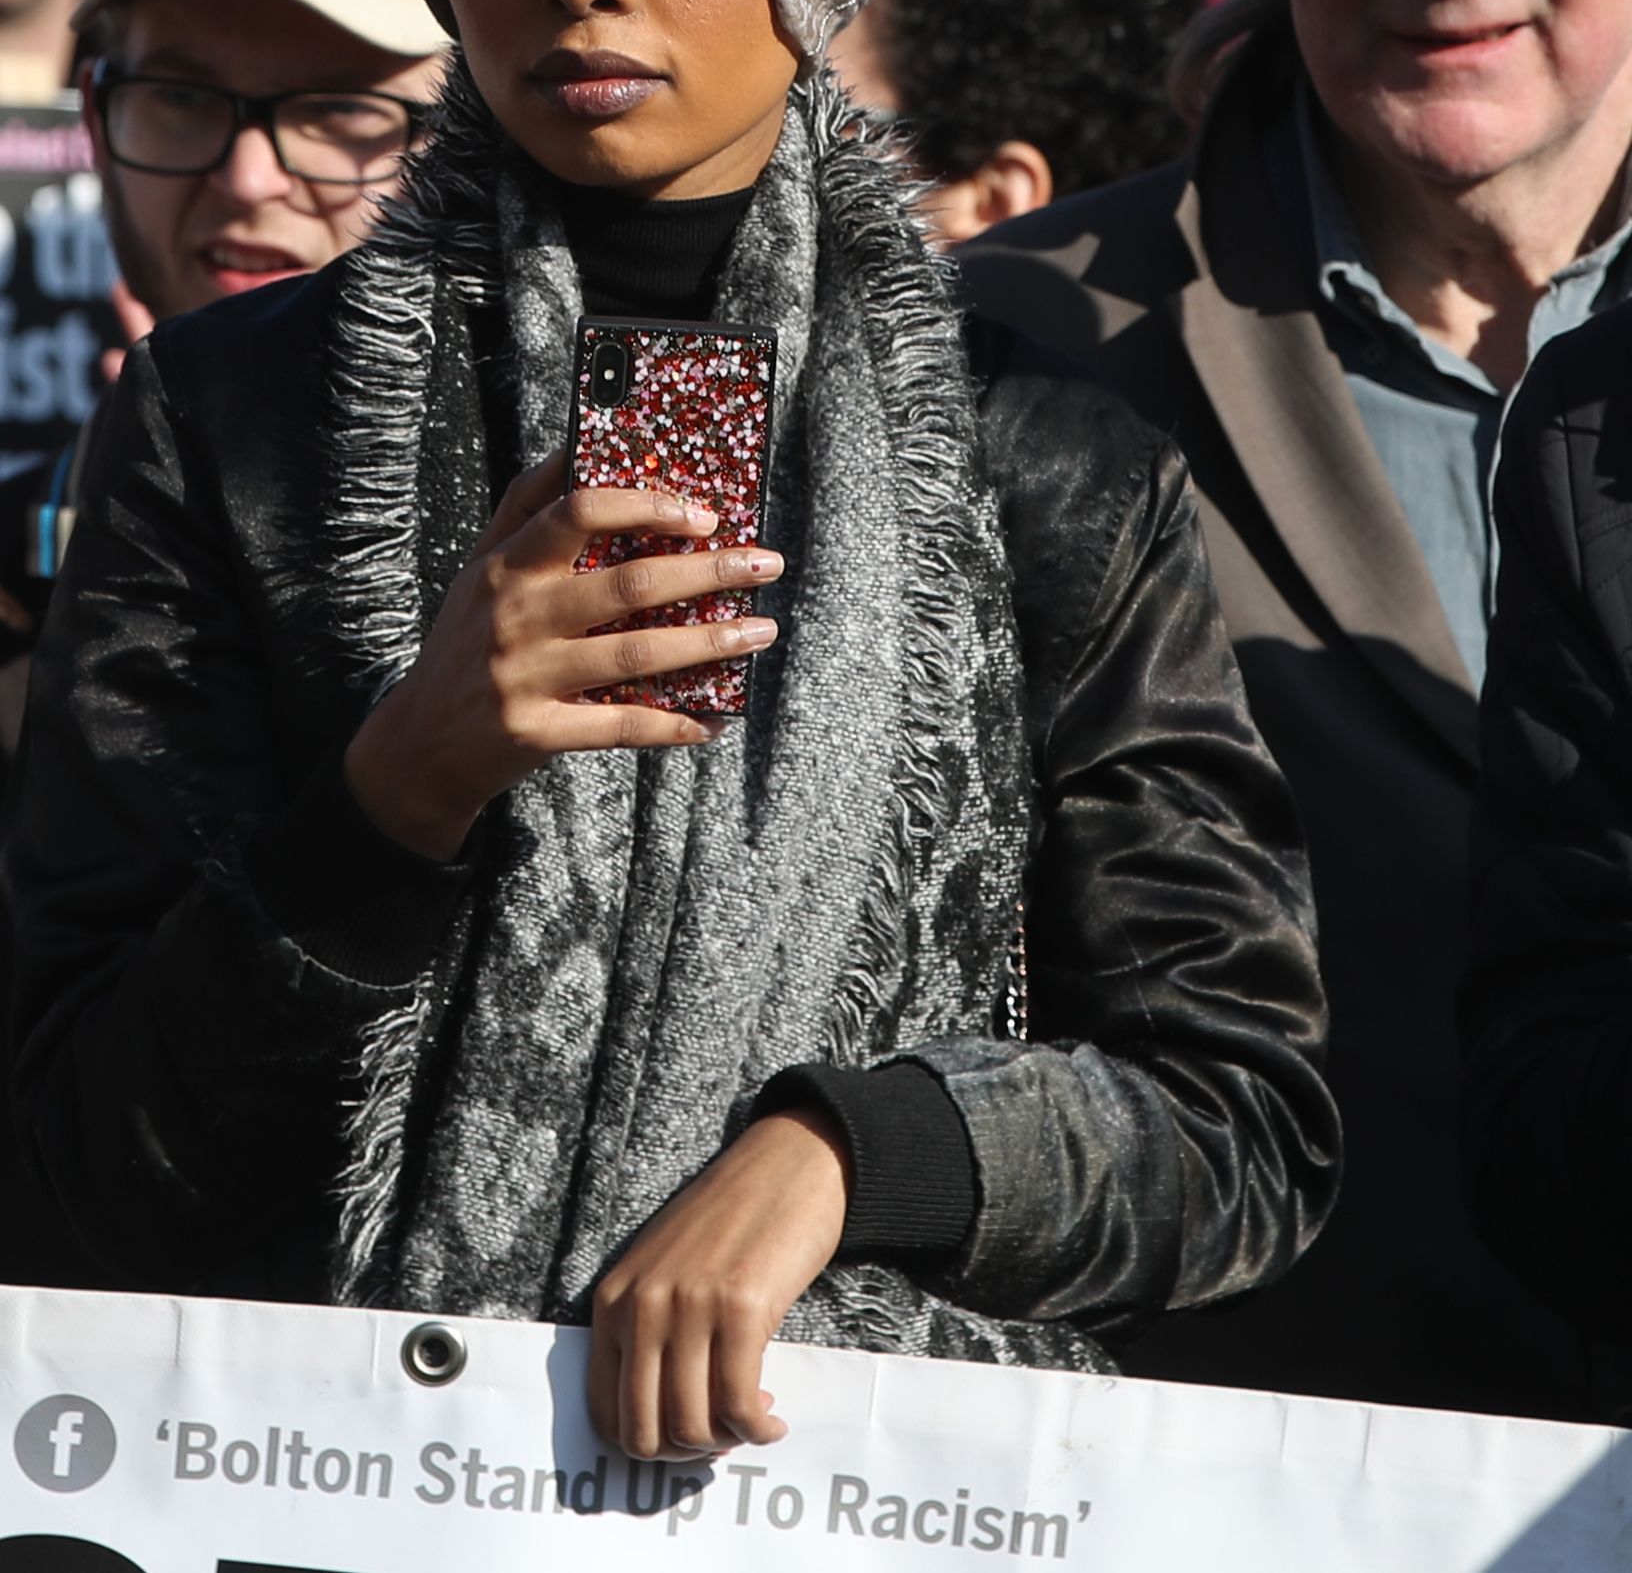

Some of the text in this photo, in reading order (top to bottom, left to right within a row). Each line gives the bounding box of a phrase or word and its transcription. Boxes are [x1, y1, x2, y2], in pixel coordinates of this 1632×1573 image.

[28, 172, 119, 301] th
[156, 1419, 1092, 1559] 'Bolton Stand Up To Racism'
